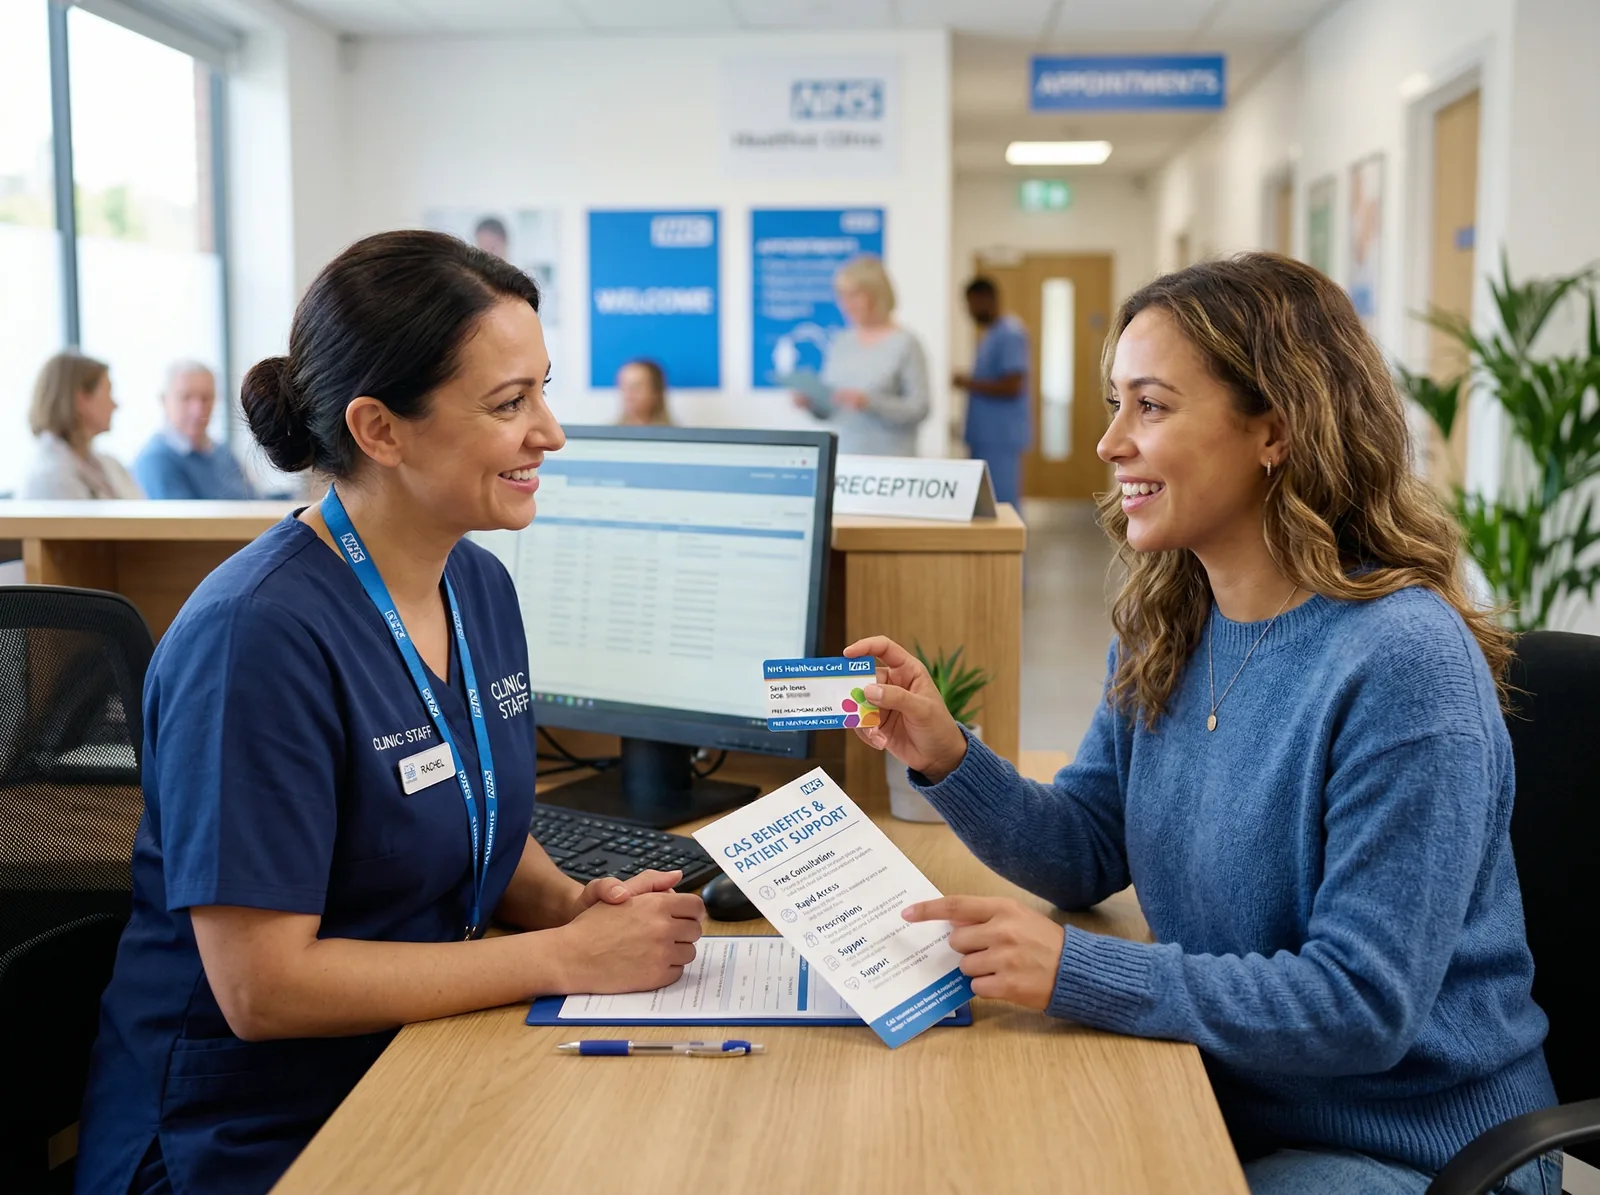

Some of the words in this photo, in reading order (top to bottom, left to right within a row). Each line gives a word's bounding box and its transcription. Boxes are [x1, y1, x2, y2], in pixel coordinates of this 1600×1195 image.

[1037, 69, 1220, 96] APPOINTMENTS
[596, 287, 713, 314] WELCOME
[834, 475, 958, 499] RECEPTION
[340, 533, 366, 563] NHS
[826, 663, 843, 671] Card
[491, 672, 527, 700] CLINIC
[499, 692, 529, 719] STAFF
[373, 733, 404, 751] CLINIC
[405, 725, 432, 743] STAFF
[420, 759, 445, 774] RACHEL
[801, 778, 824, 795] NHS
[724, 837, 753, 858] CAS
[751, 806, 813, 844] BENEFITS
[812, 800, 826, 812] &
[734, 837, 789, 873] PATIENT
[789, 805, 848, 844] SUPPORT
[795, 894, 816, 910] Rapid
[816, 883, 840, 899] Access
[816, 905, 863, 933] Prescriptions
[838, 936, 867, 956] Support
[860, 958, 889, 978] Support
